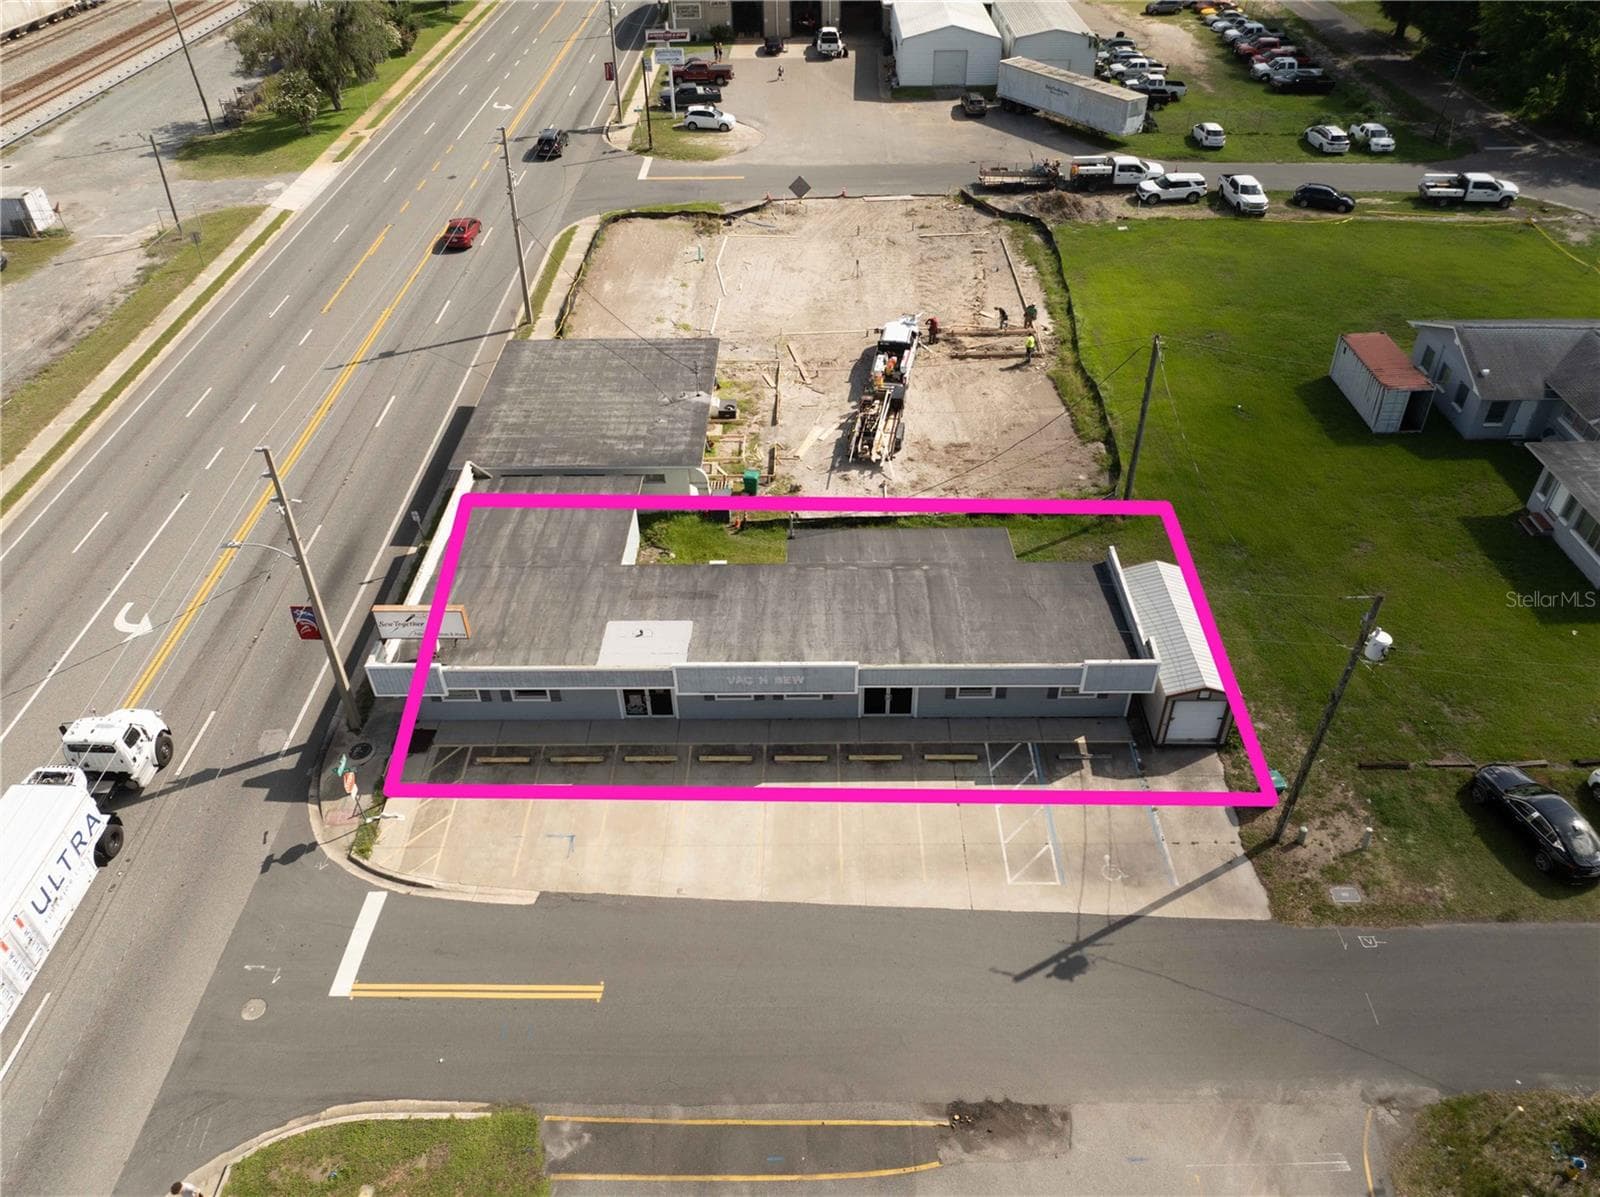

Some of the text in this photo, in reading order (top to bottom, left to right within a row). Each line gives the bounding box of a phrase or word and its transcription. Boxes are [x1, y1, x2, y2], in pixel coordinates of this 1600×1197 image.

[726, 675, 754, 685] VAC
[758, 675, 769, 685] N
[31, 813, 101, 914] ULTRA
